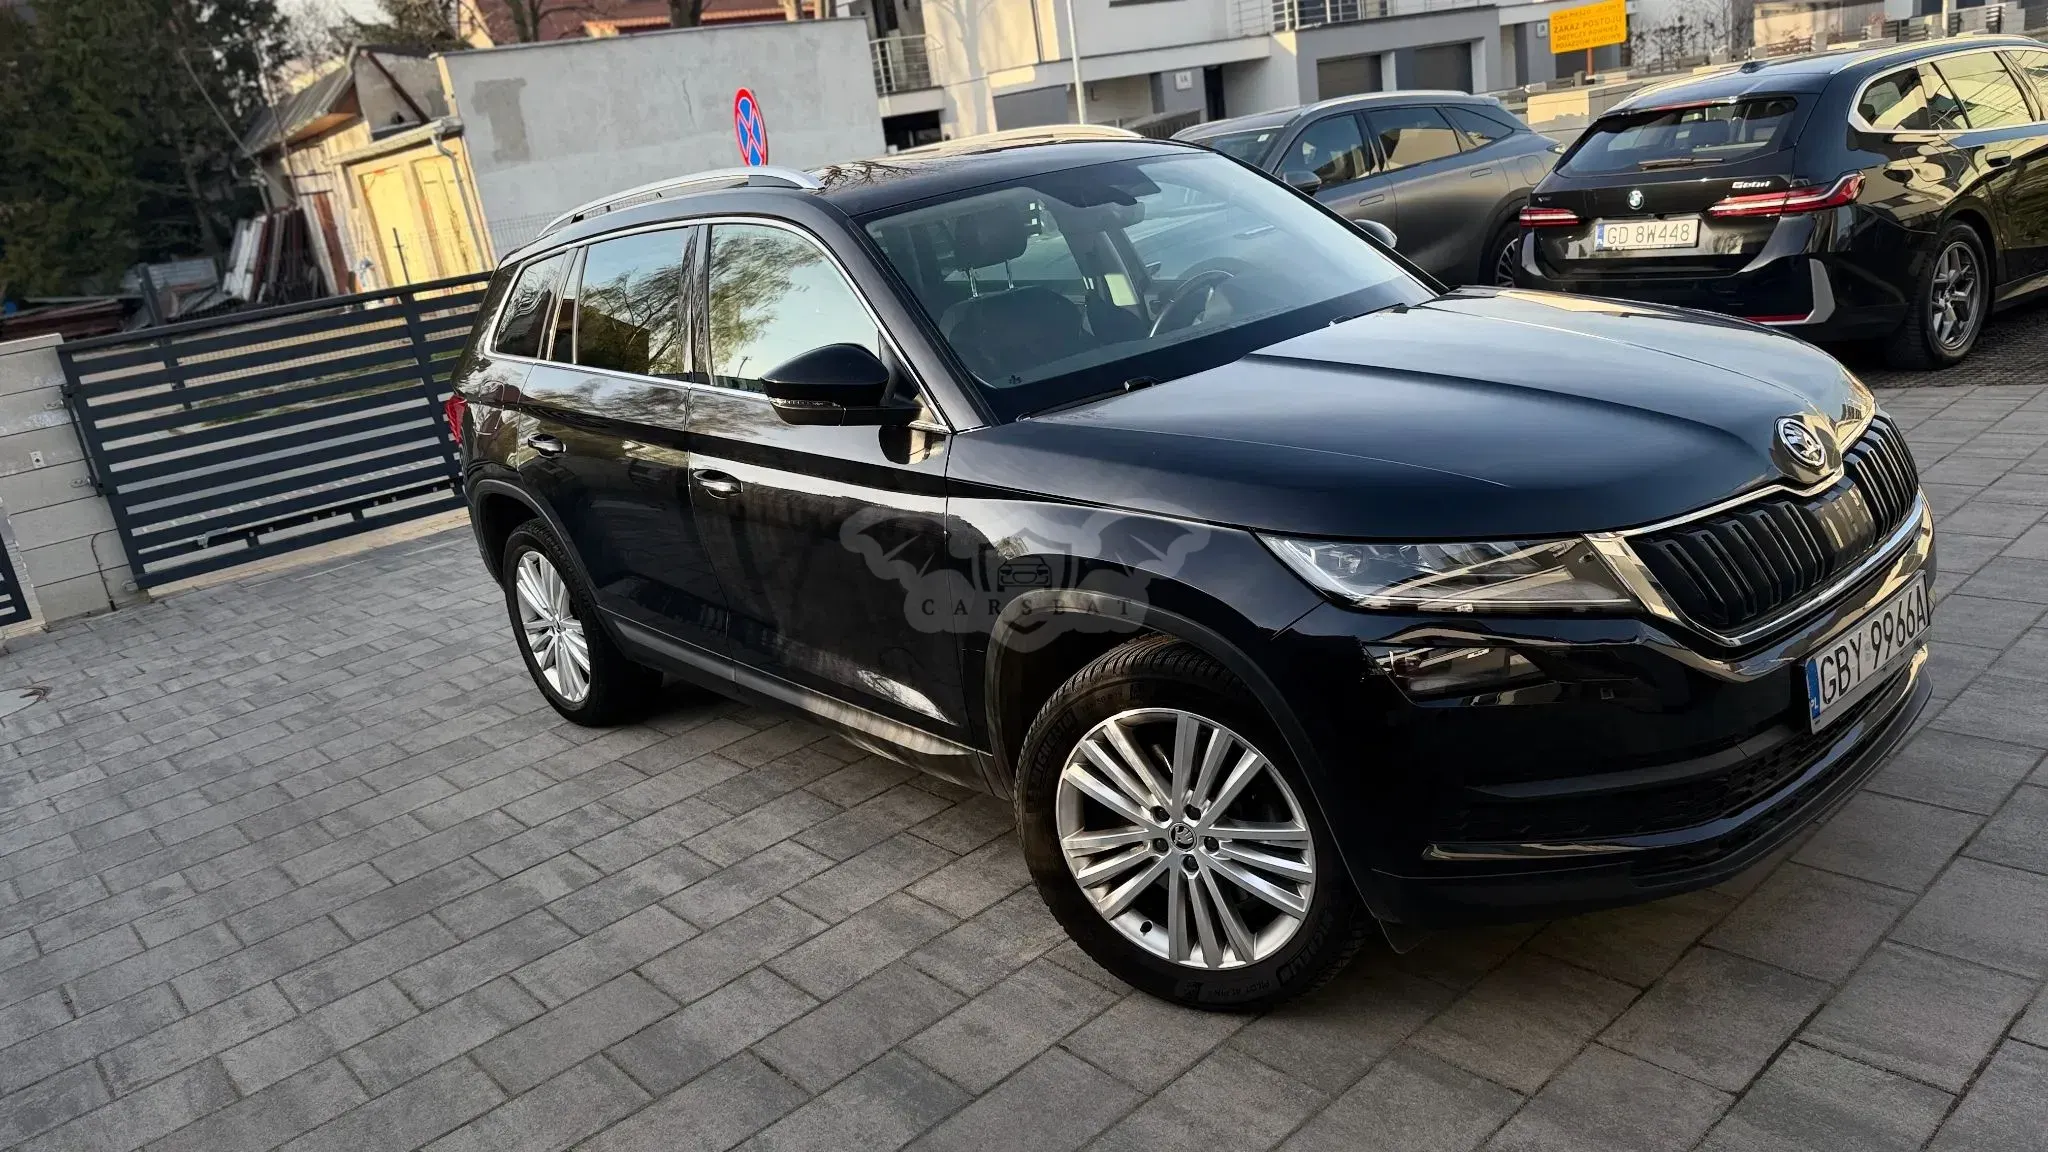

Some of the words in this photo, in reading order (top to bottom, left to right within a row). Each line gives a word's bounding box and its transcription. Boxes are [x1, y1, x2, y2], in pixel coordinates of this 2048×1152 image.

[1553, 22, 1580, 34] ZAKAZ
[1582, 15, 1622, 28] POSTOJU
[1607, 226, 1629, 245] GD
[1635, 223, 1690, 243] 8W448
[1820, 632, 1862, 705] GBY
[1870, 584, 1927, 670] 9966A
